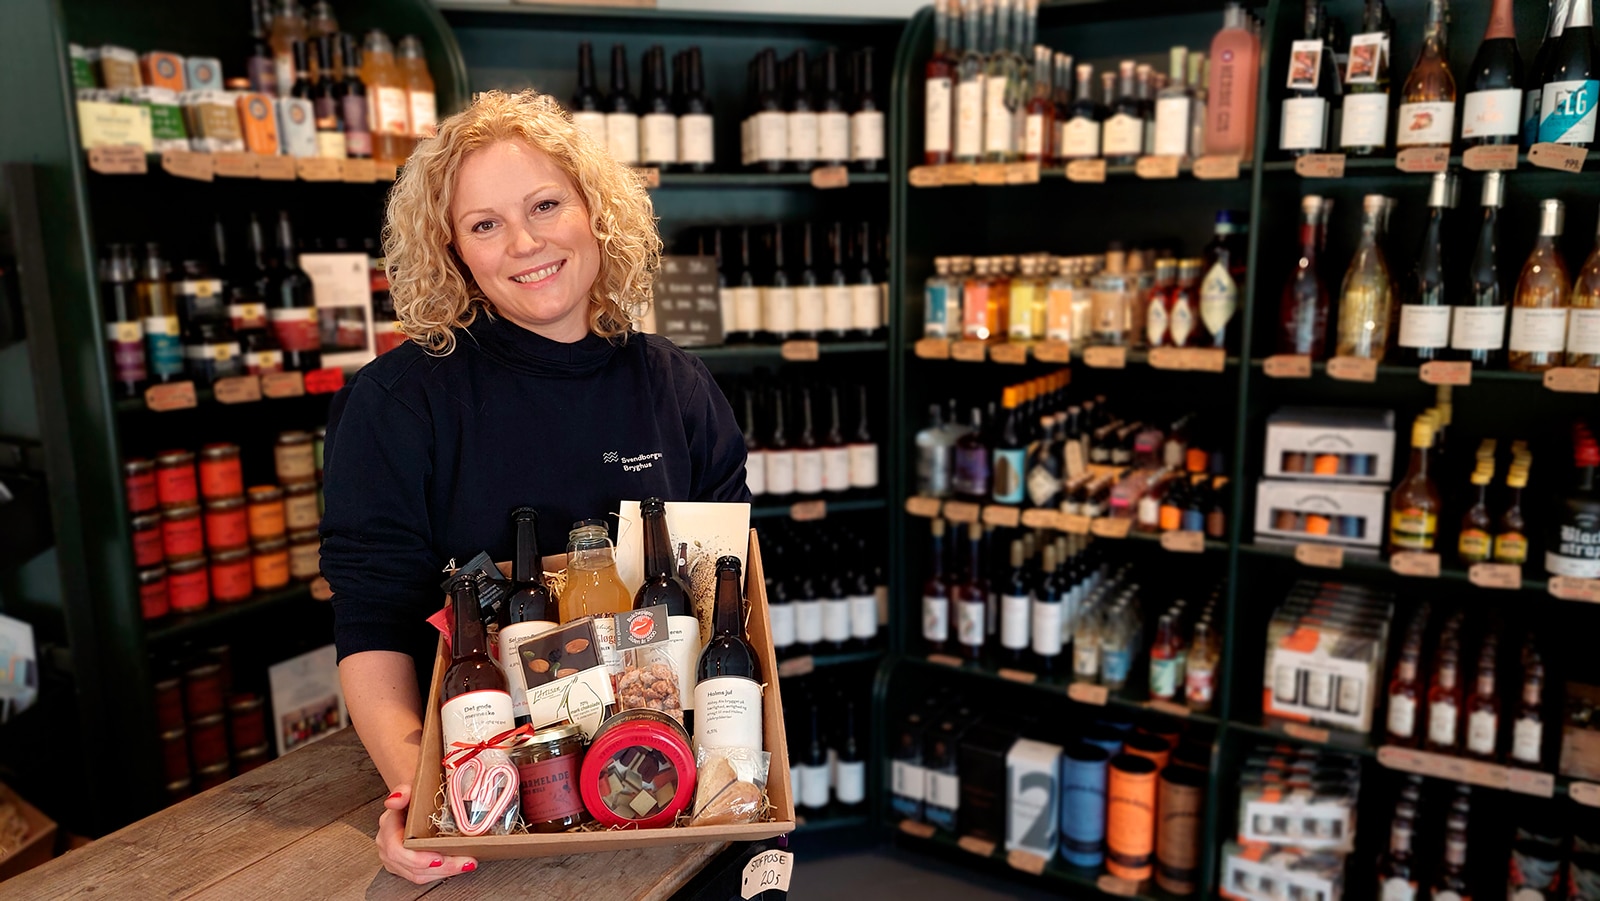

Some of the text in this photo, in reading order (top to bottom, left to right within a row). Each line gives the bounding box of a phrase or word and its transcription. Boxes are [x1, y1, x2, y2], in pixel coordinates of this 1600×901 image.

[1553, 89, 1588, 115] ELG
[623, 463, 652, 472] Bryghus
[724, 689, 733, 697] Jul
[1019, 771, 1054, 850] 2
